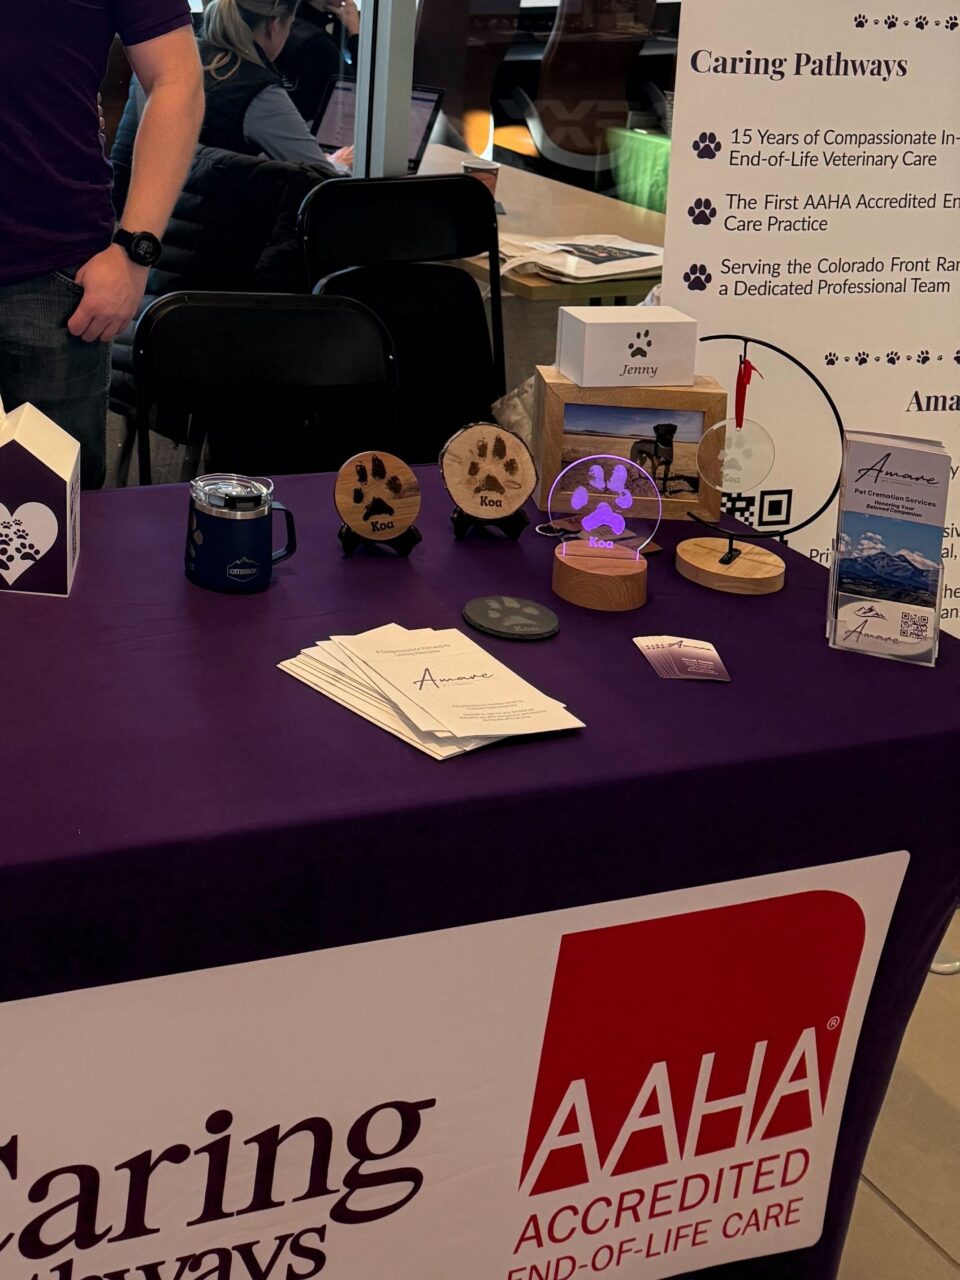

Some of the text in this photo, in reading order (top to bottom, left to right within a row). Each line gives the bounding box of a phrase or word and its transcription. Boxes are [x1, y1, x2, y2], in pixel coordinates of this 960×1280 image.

[690, 49, 908, 82] Caring Pathways
[731, 128, 752, 145] 15
[757, 128, 800, 145] Years
[803, 128, 821, 145] of
[823, 128, 937, 149] Compassionate
[729, 150, 937, 169] End-of-Life Veterinary Care
[726, 193, 757, 210] The
[764, 194, 799, 210] First
[803, 194, 852, 210] AAHA
[856, 192, 936, 209] Accredited
[724, 215, 828, 232] Care Practice
[720, 258, 781, 278] Serving
[787, 258, 812, 274] the
[817, 256, 885, 273] Colorado
[891, 256, 931, 272] Front
[718, 277, 951, 296] a Dedicated Professional Team
[619, 364, 659, 378] Jenny
[854, 452, 940, 485] Amare
[480, 496, 502, 508] Koa
[854, 487, 937, 508] Pet Cremation Services
[371, 520, 395, 533] Koa
[588, 536, 614, 549] Koa
[413, 667, 494, 691] Amare
[518, 1027, 824, 1197] AAHA
[512, 1148, 810, 1255] ACCREDITED
[721, 1198, 804, 1240] CARE
